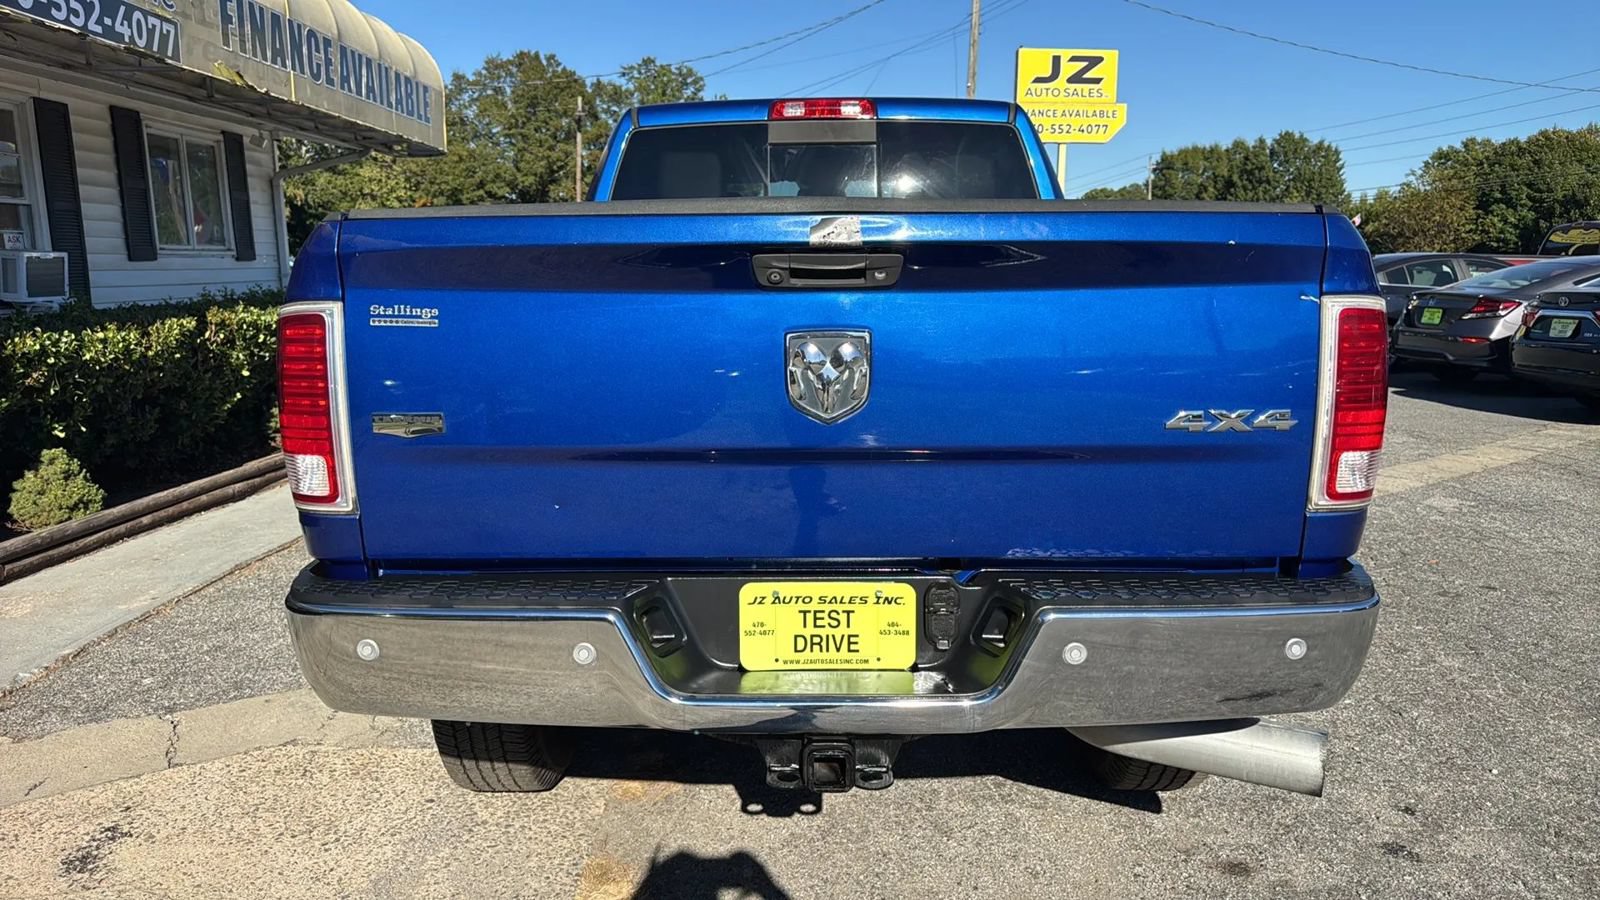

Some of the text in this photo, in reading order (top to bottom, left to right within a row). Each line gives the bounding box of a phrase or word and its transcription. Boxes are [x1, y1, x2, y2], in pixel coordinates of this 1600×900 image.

[219, 0, 432, 125] FINANCE AVAILABLE
[1030, 55, 1105, 84] JZ
[1025, 88, 1060, 97] AUTO
[1061, 109, 1118, 118] AVAILABLE
[1034, 124, 1109, 134] 0-552-4077
[370, 304, 439, 319] Stallings
[747, 595, 906, 605] JZ AUTO SALES INC.
[798, 609, 855, 629] TEST
[793, 634, 860, 653] DRIVE
